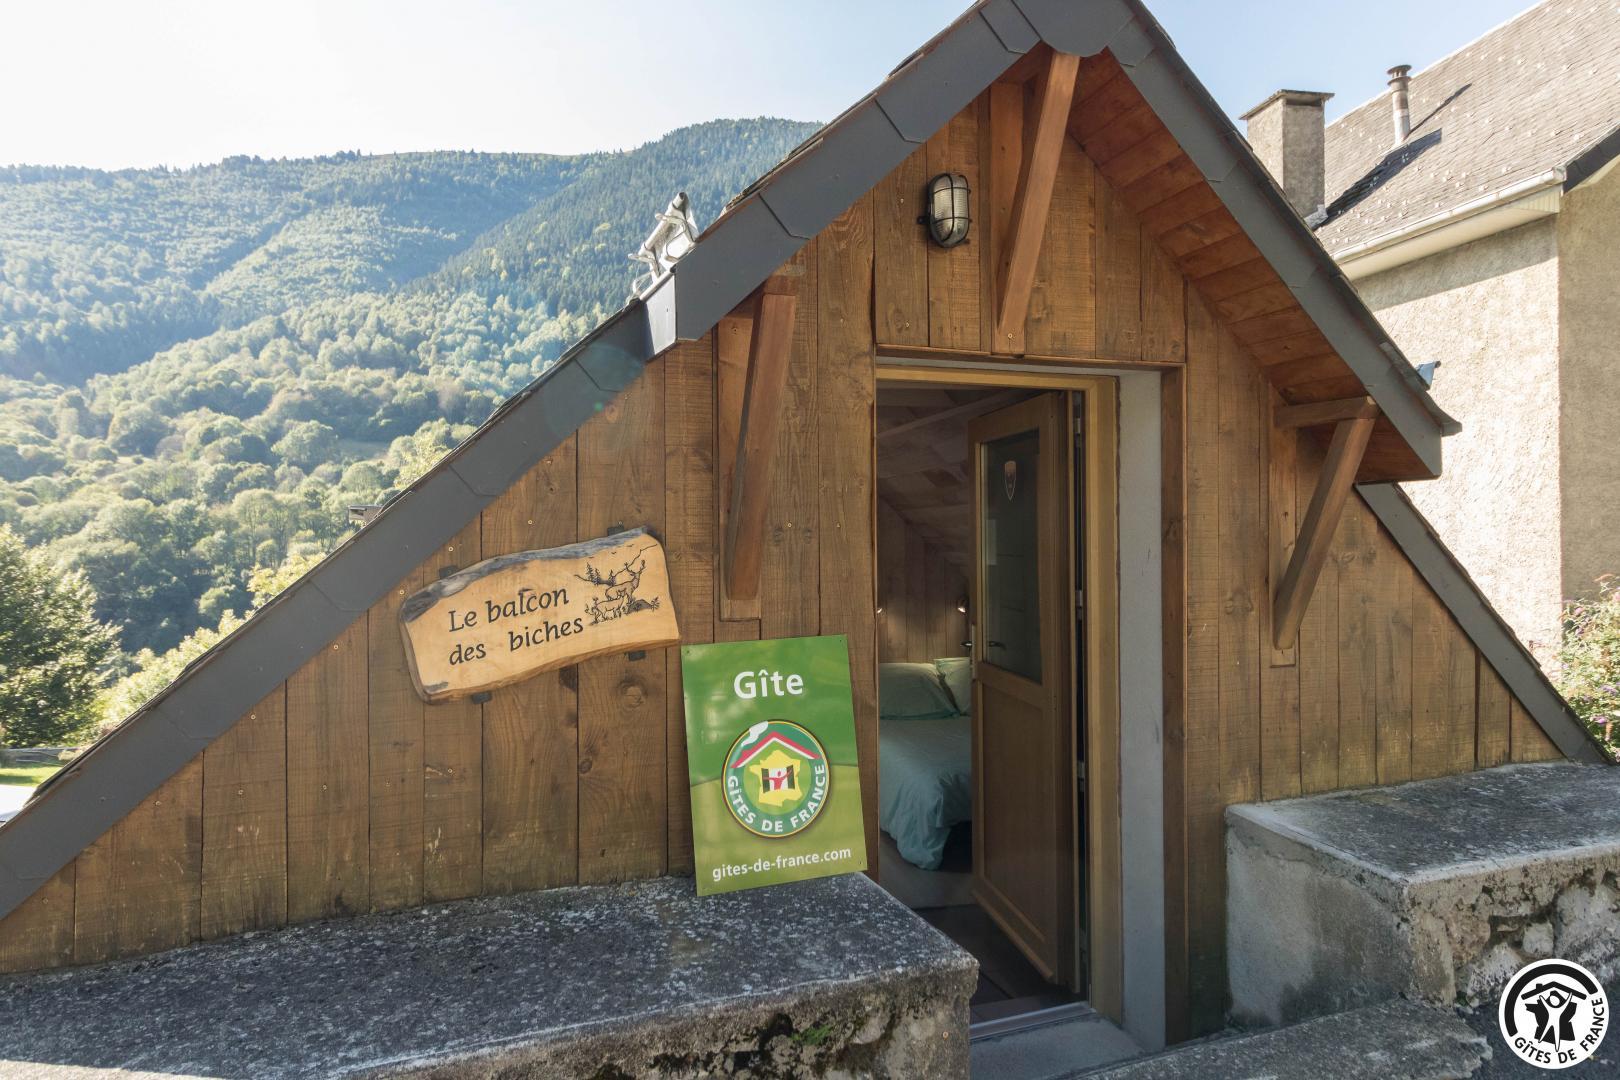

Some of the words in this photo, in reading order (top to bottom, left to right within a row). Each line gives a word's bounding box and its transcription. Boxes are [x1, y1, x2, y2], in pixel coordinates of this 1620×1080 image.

[449, 609, 477, 632] Le
[485, 587, 570, 624] balcon
[449, 643, 487, 665] des
[507, 616, 584, 651] biches
[733, 669, 804, 699] Gîte
[761, 819, 783, 832] DE
[790, 764, 825, 827] FRANCE
[712, 848, 852, 882] gites-de-france.com
